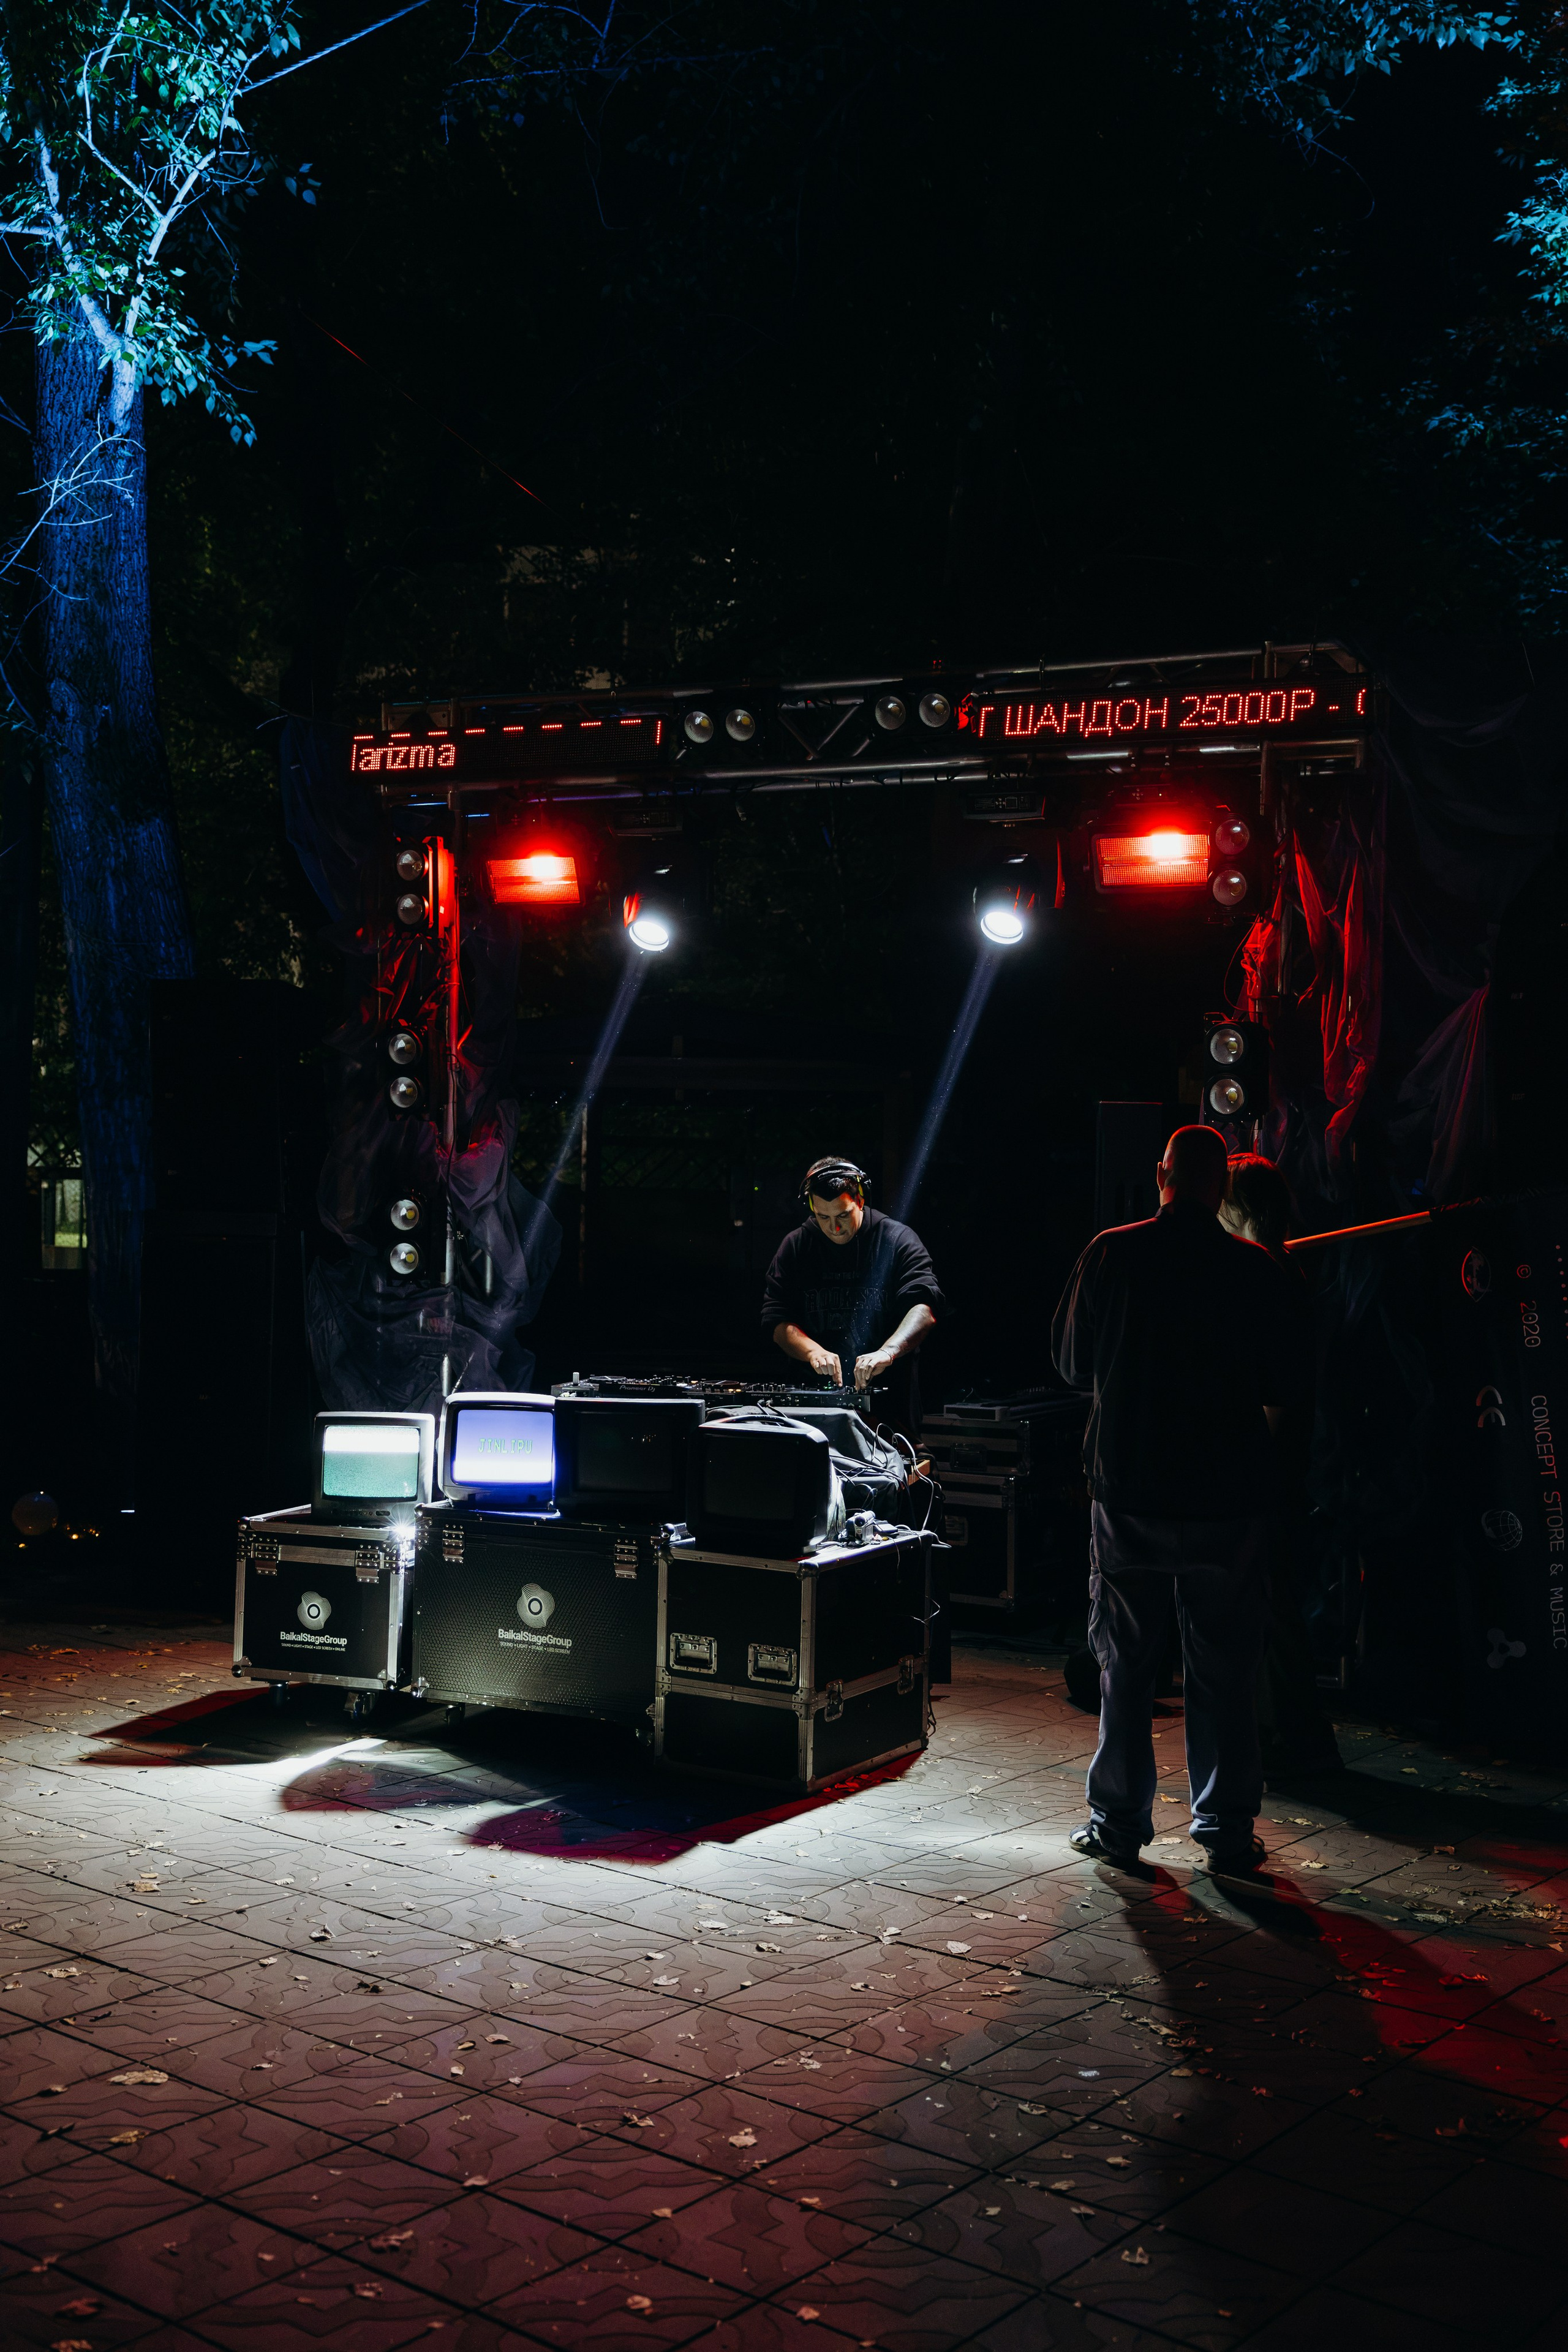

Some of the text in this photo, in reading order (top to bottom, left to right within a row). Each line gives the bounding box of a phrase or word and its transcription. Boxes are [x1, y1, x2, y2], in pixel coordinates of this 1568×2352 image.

[1005, 697, 1169, 738] ШАНДОН
[1520, 1300, 1541, 1348] 2020
[478, 1438, 533, 1455] JINLIPU
[1531, 1395, 1558, 1479] CONCEPT
[1543, 1491, 1566, 1552] STORE
[280, 1631, 347, 1646] BaikalStageGroup
[498, 1629, 572, 1648] BaikalStageGroup
[1549, 1586, 1568, 1649] MUSIC
